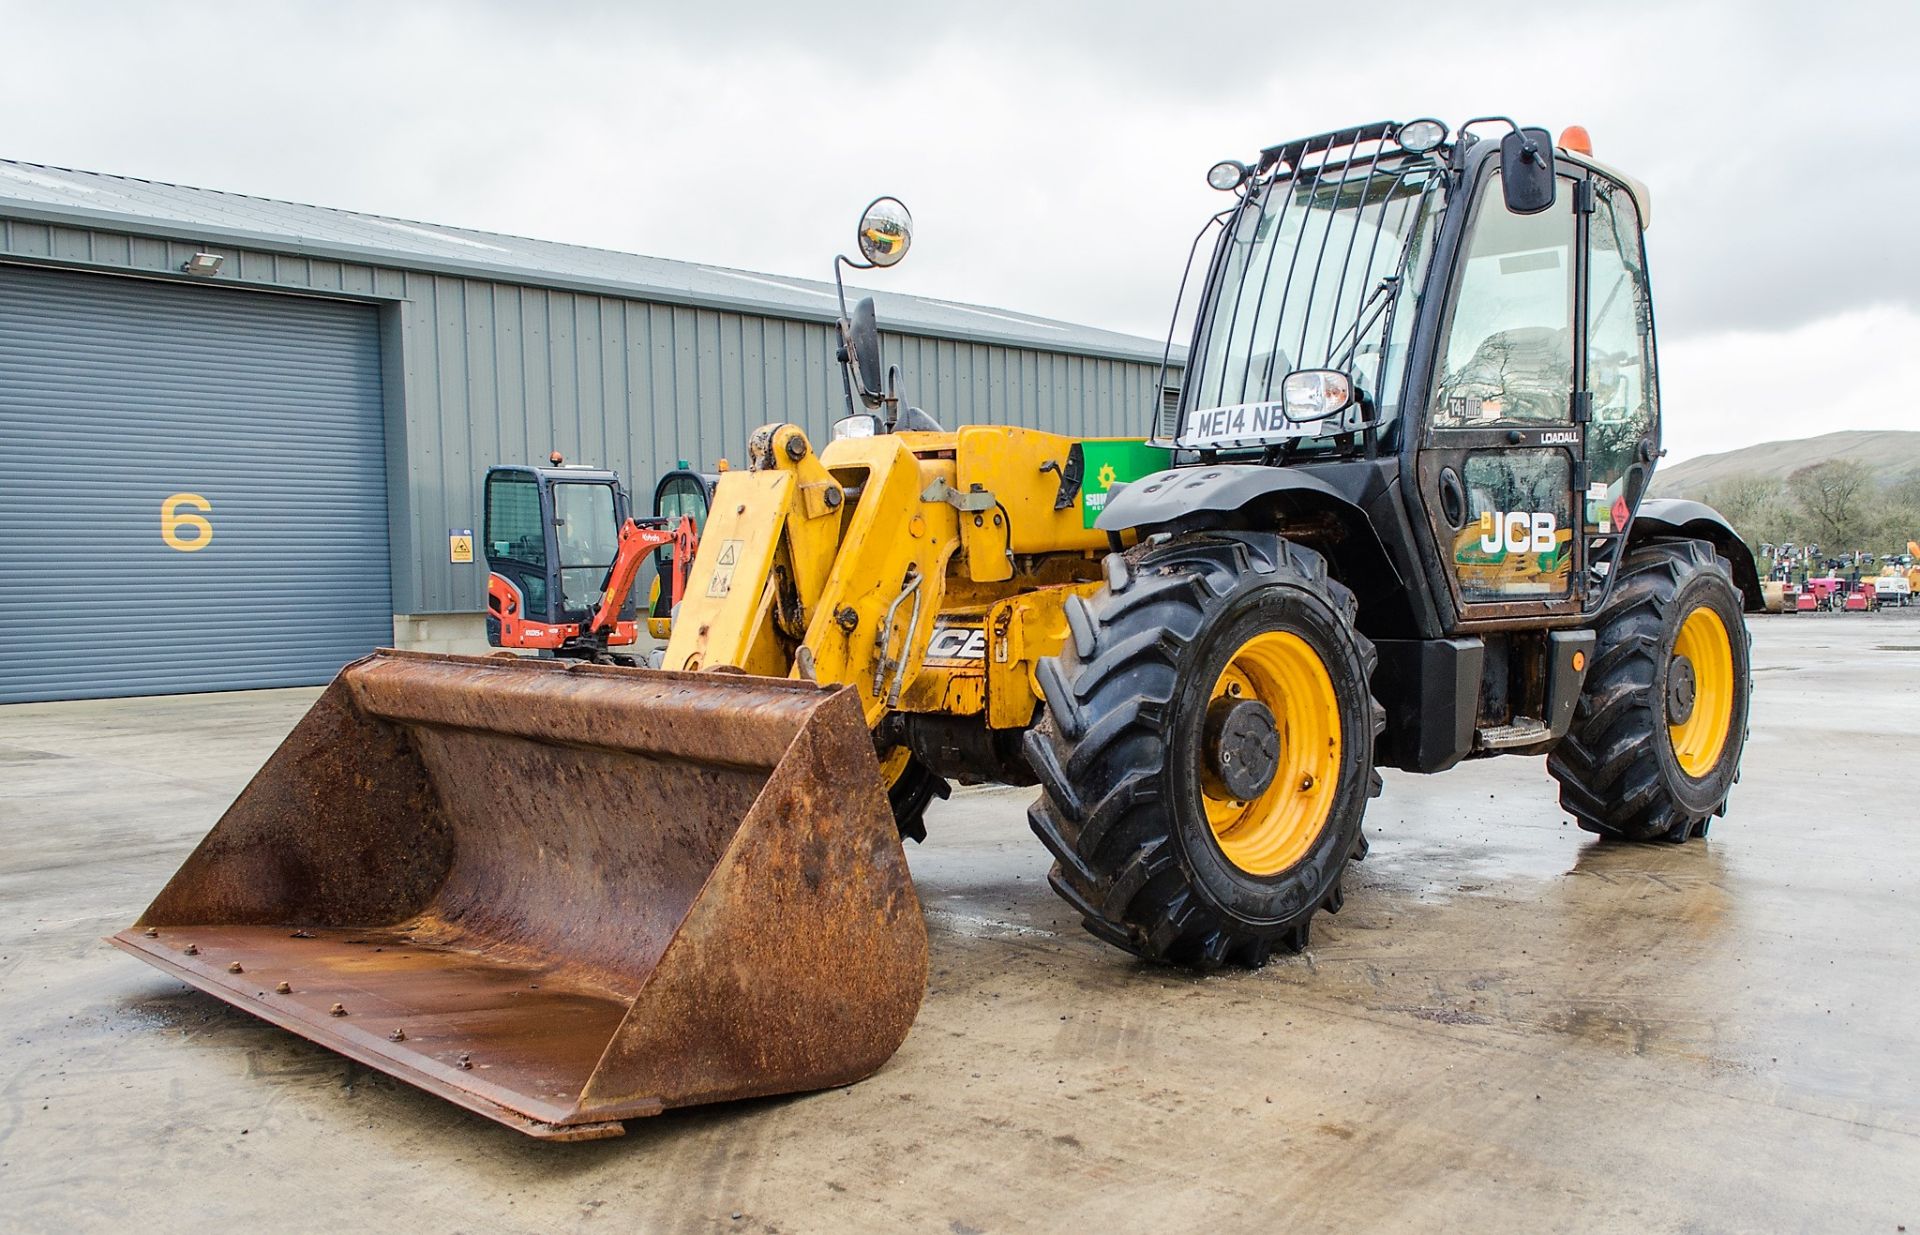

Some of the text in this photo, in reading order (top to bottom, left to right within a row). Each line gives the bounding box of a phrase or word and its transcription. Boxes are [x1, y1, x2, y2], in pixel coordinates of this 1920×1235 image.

[1198, 408, 1245, 438] ME14
[1541, 433, 1578, 443] LOADALL
[161, 493, 213, 551] 6
[1481, 512, 1556, 553] JCB
